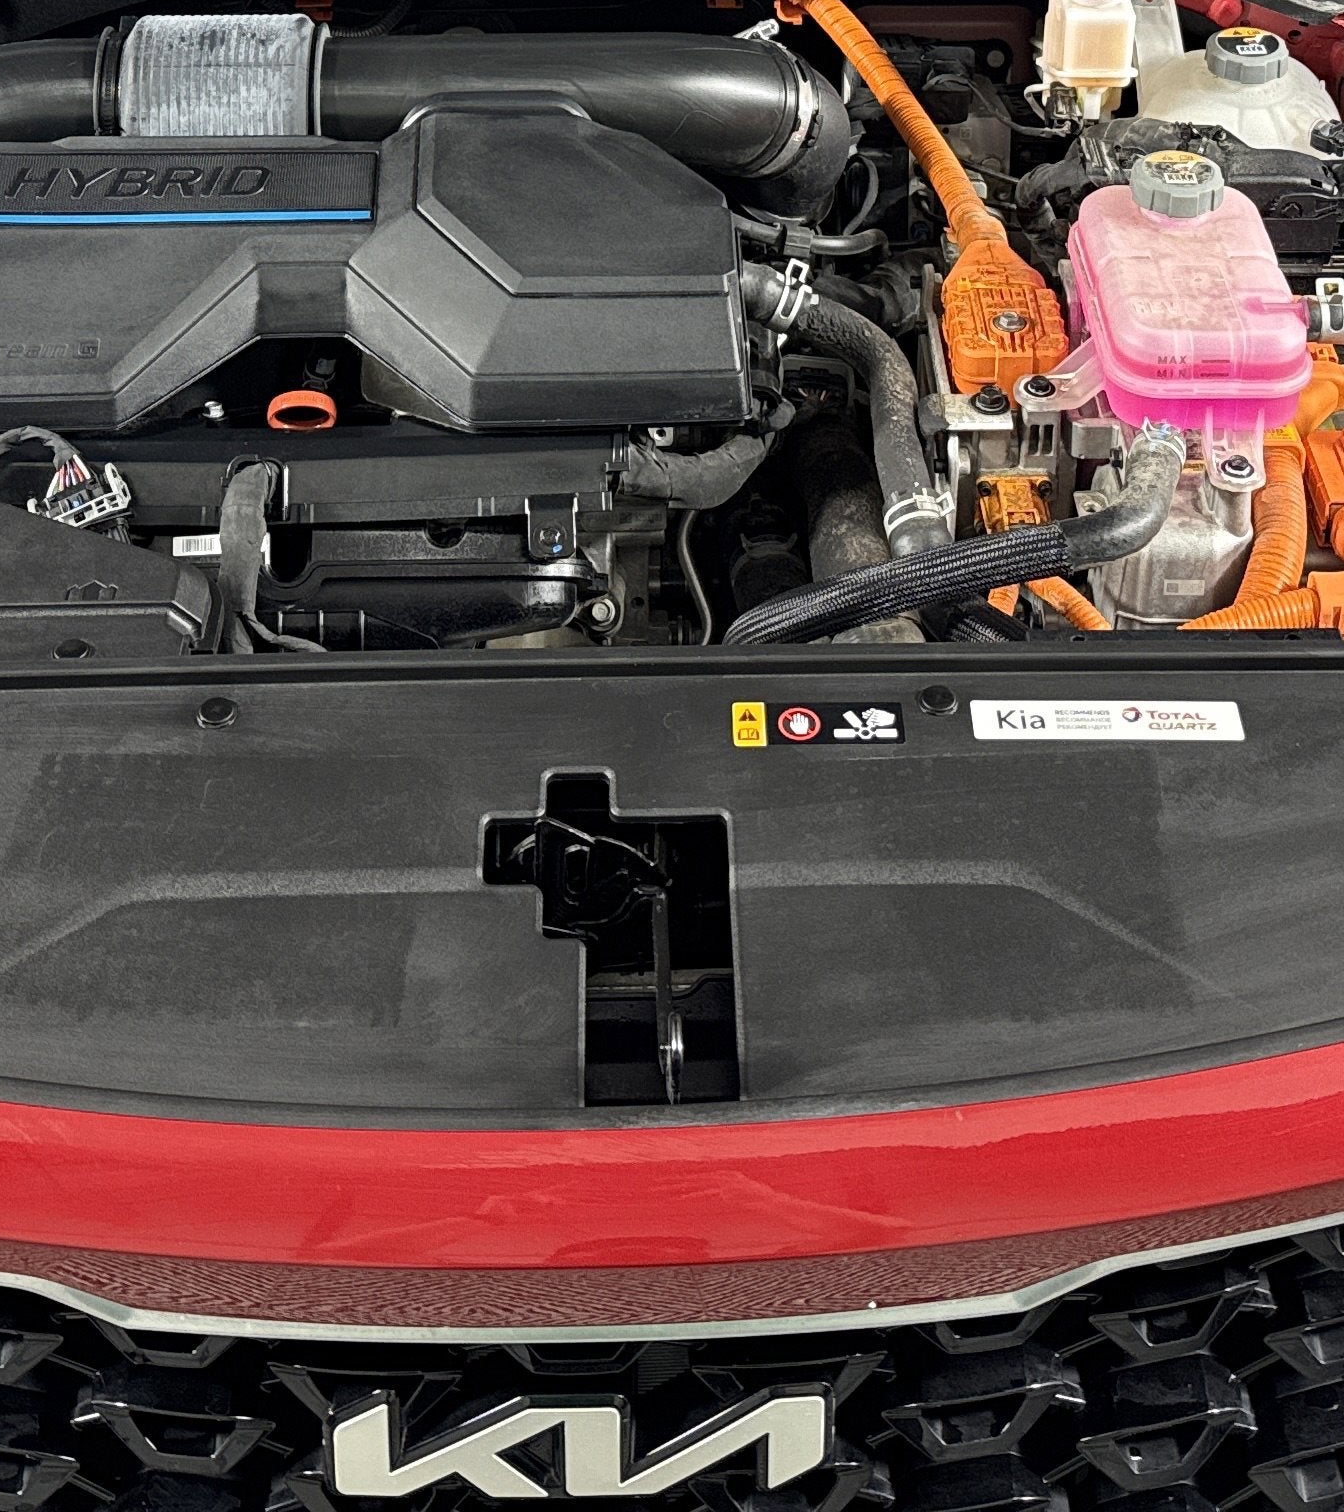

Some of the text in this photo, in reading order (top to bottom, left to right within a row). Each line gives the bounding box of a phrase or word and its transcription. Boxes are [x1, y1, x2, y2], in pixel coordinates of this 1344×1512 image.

[5, 165, 273, 200] HYBRID
[1157, 355, 1187, 365] MAX
[1156, 369, 1186, 378] MIN
[996, 710, 1046, 730] Kia
[1148, 722, 1217, 731] QUARTZ
[333, 1396, 824, 1496] KIA
